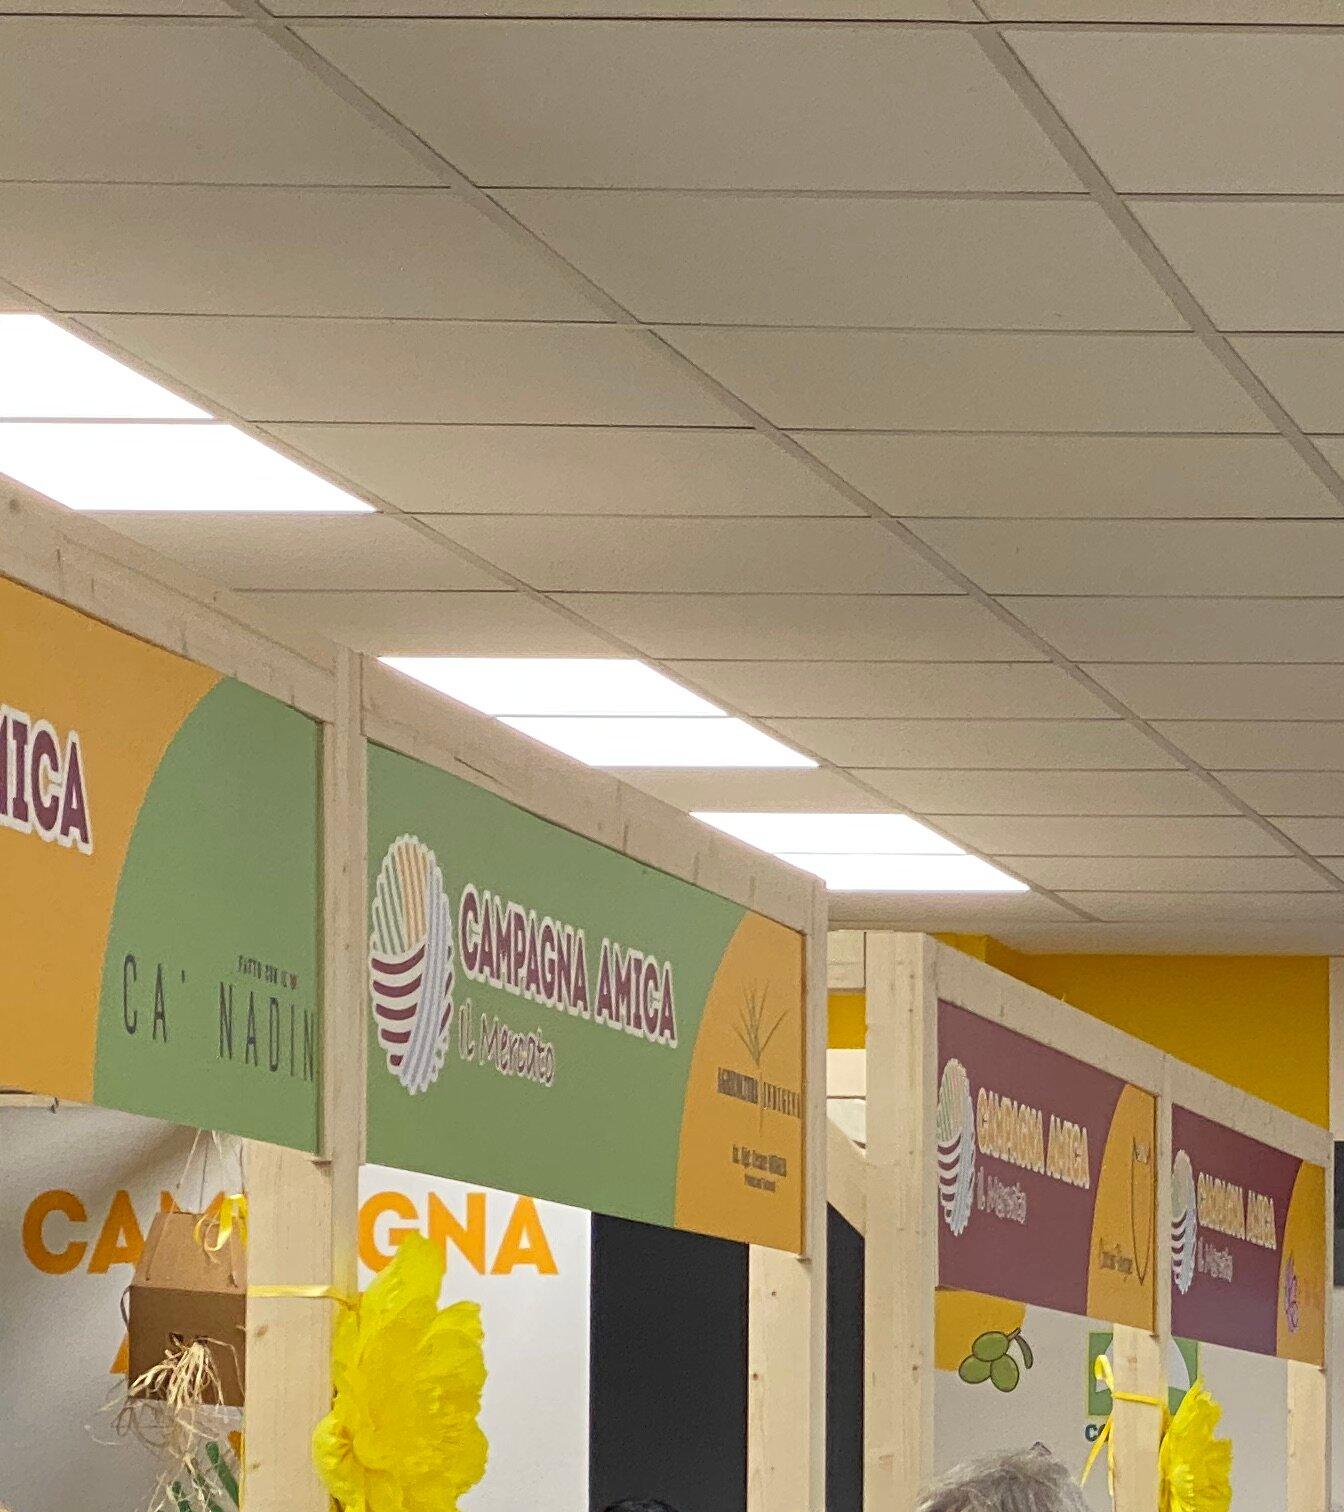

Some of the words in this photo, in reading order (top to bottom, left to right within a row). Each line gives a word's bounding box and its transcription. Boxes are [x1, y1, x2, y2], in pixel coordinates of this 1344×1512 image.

[459, 883, 591, 1019] CAMPAGNA
[595, 938, 678, 1048] AMICA
[459, 998, 477, 1061] Il
[479, 1012, 556, 1087] Mercato
[977, 1088, 1045, 1174] CAMPAGNA
[1046, 1113, 1090, 1189] AMICA
[1197, 1172, 1245, 1240] CAMPAGNA
[1246, 1190, 1277, 1250] AMICA
